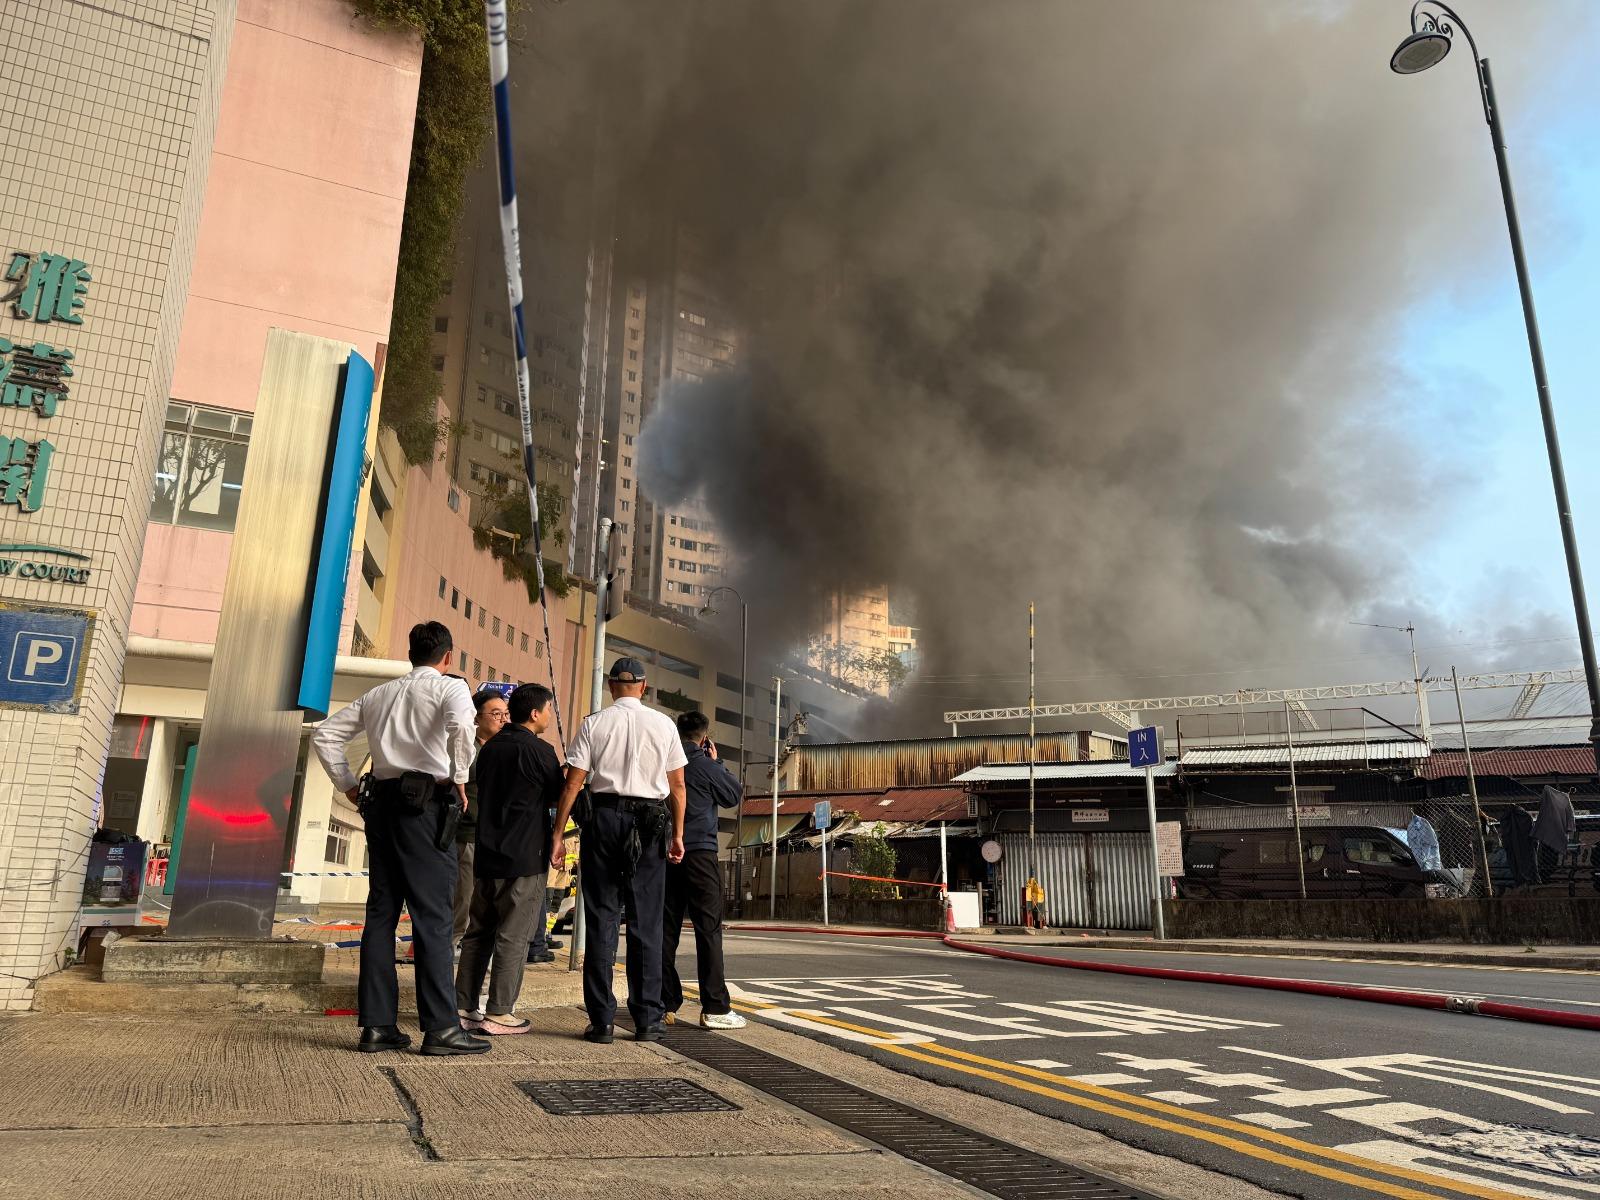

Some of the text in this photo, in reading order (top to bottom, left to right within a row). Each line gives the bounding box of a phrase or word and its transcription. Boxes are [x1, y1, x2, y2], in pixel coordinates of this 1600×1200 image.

[20, 562, 91, 584] COURT
[24, 639, 63, 676] P
[1137, 731, 1147, 743] IN
[1139, 747, 1149, 761] 入
[755, 1000, 1284, 1045] CLEAR
